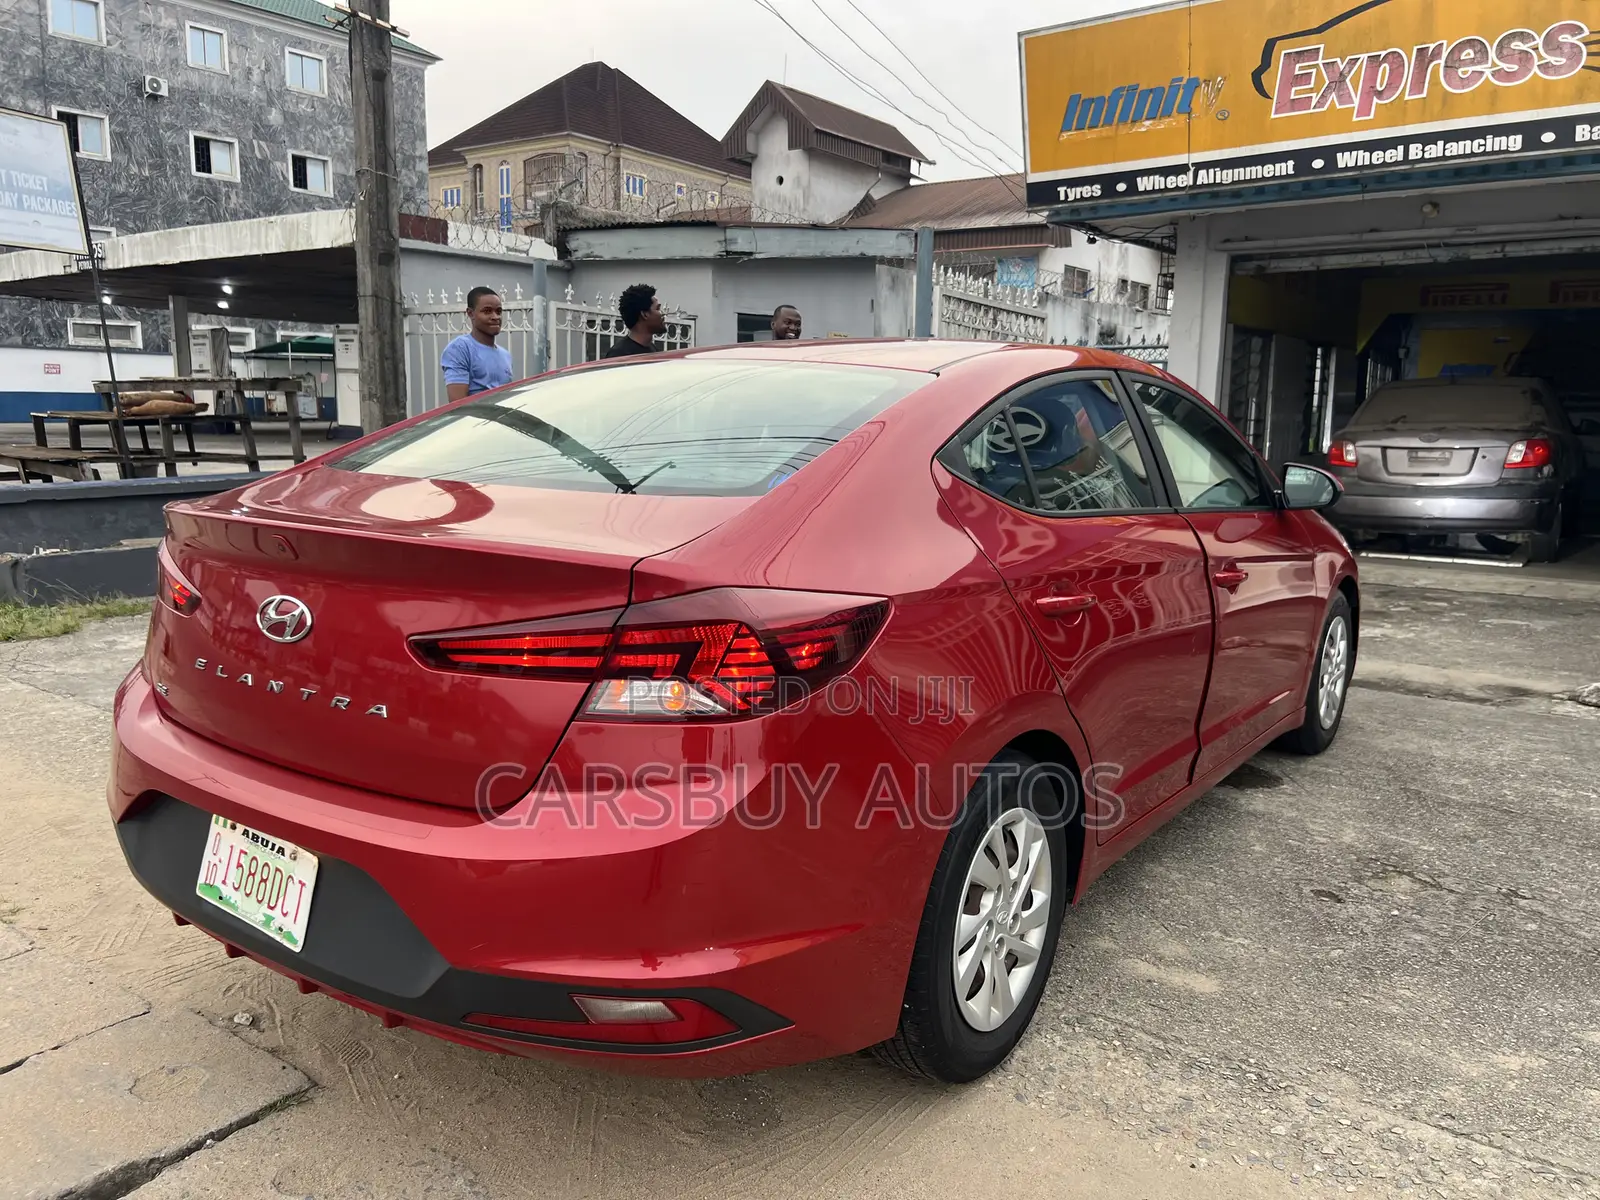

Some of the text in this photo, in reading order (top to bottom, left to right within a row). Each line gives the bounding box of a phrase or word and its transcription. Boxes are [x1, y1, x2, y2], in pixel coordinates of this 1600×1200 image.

[1270, 20, 1590, 121] Express
[10, 170, 47, 192] TICKET
[1057, 182, 1102, 201] Tyres
[1136, 170, 1194, 192] Wheel
[1196, 159, 1296, 185] Alignment
[1336, 145, 1404, 169] Wheel
[1408, 134, 1523, 161] Balancing
[22, 194, 78, 217] PACKAGES
[1419, 283, 1511, 307] PIRELLI
[195, 658, 388, 719] ELANTRA
[241, 828, 286, 857] ABUJA
[221, 844, 307, 925] 1588DCT
